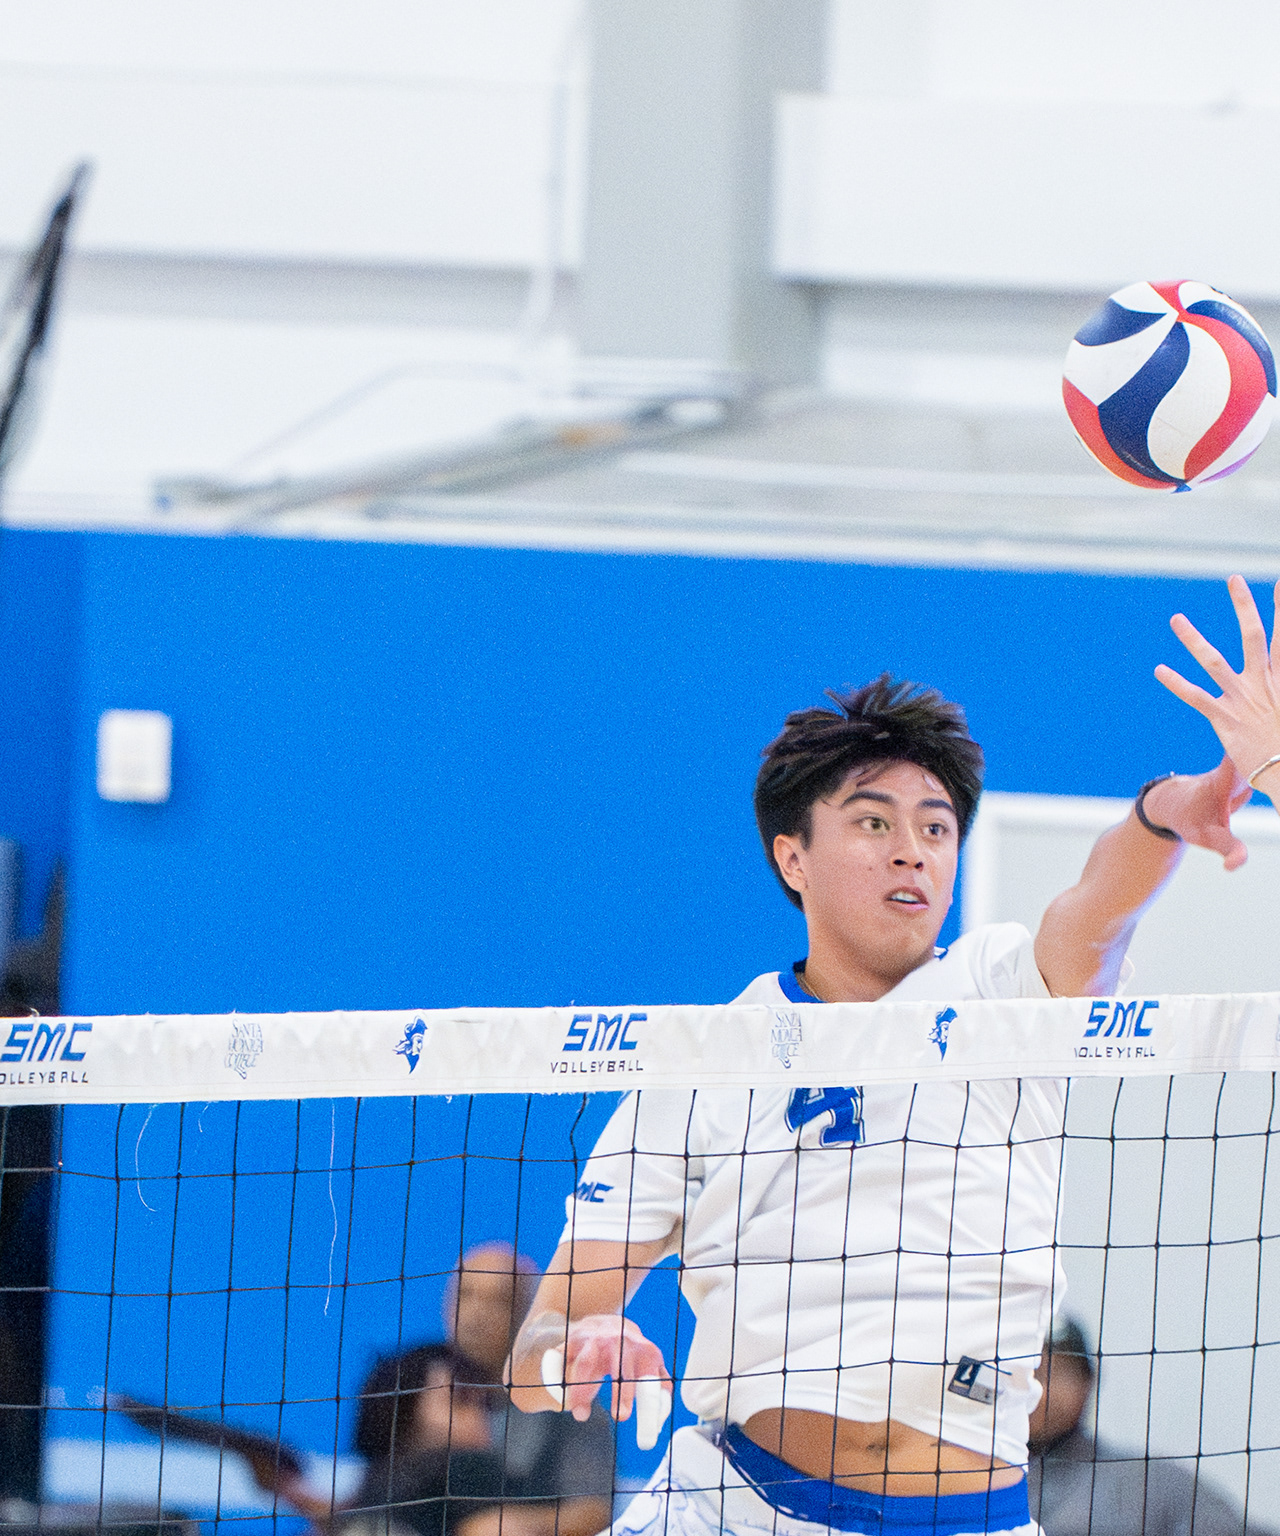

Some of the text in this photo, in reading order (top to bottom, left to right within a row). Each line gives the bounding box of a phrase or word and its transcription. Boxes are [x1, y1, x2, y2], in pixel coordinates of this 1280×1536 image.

[562, 1013, 648, 1051] SMC
[1083, 1000, 1160, 1038] SMC
[0, 1022, 93, 1063] SMC
[550, 1060, 644, 1073] VOLLEYBALL
[576, 1181, 614, 1203] MC
